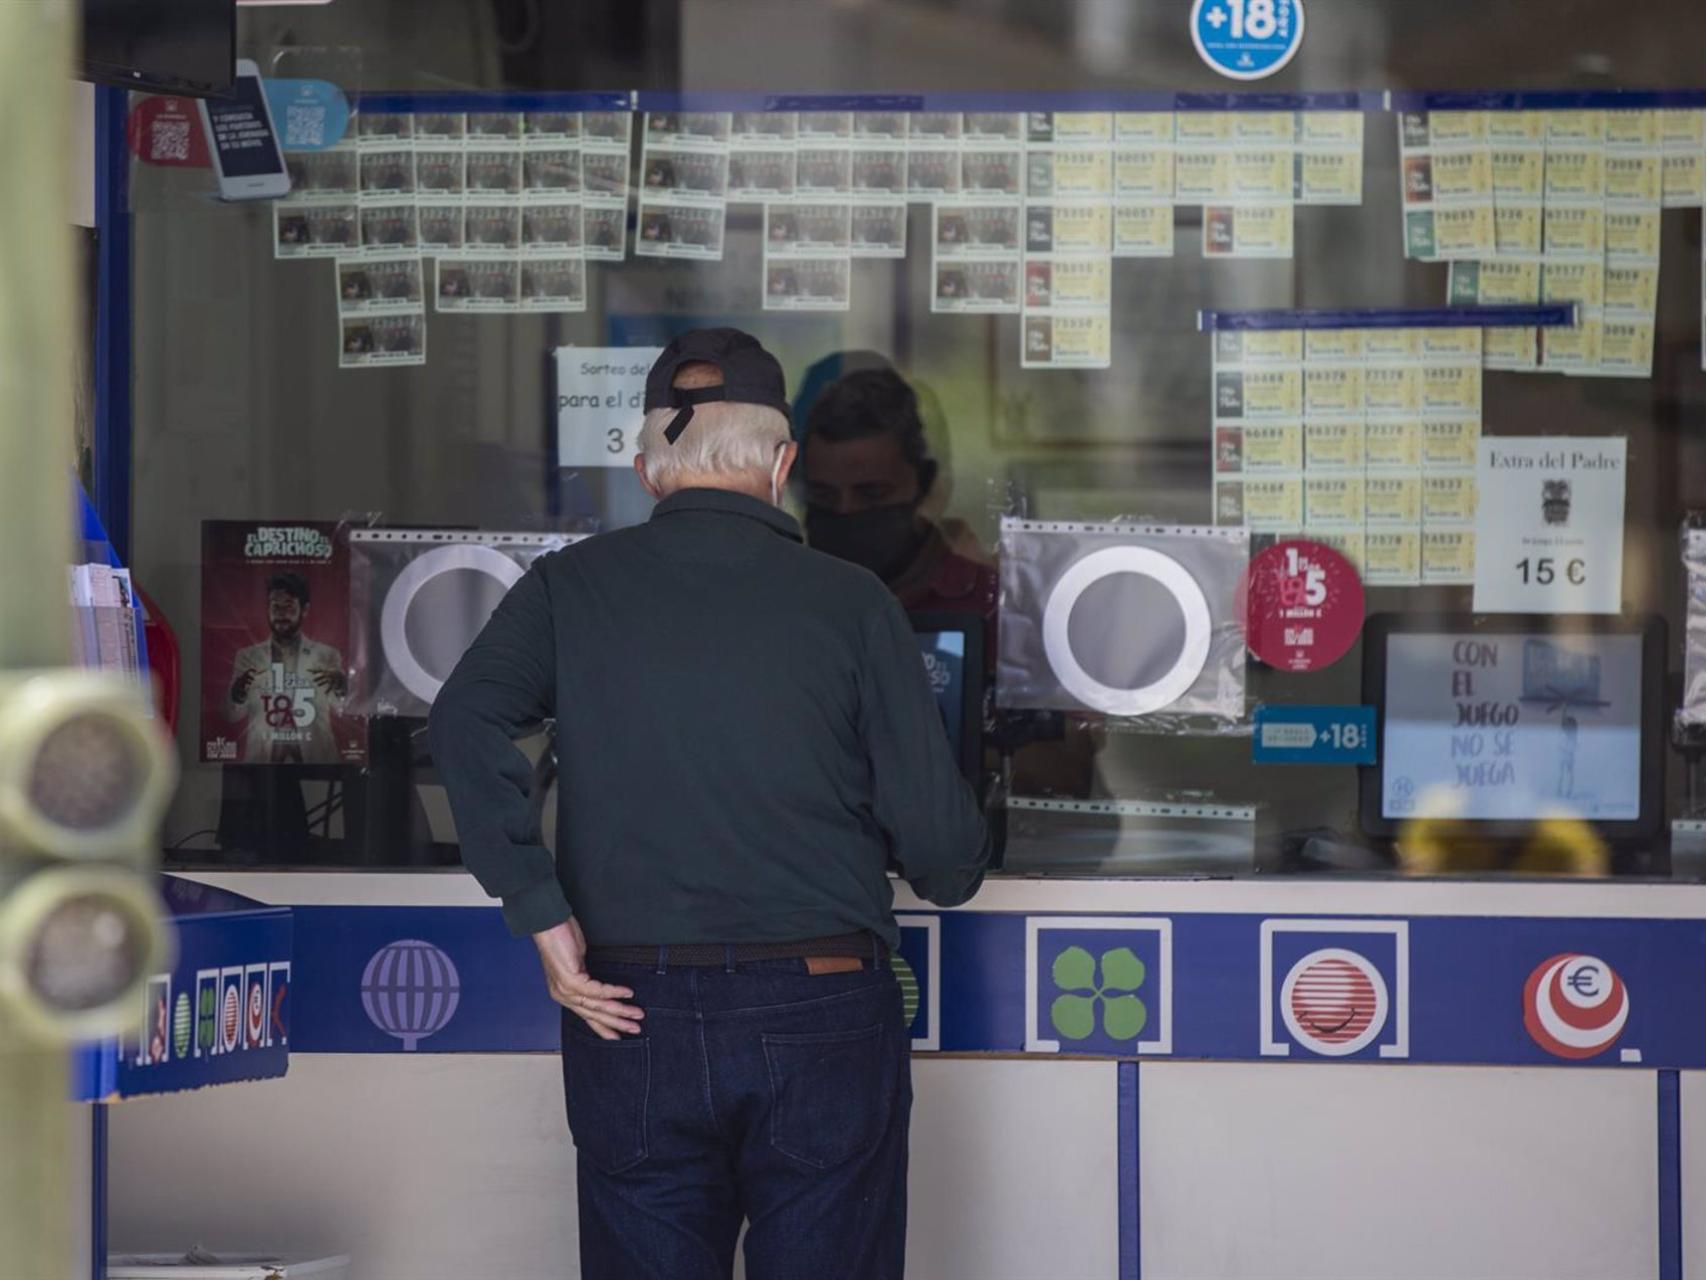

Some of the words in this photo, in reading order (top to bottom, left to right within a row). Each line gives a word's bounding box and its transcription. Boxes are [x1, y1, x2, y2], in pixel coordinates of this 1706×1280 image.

[1206, 0, 1277, 39] +18
[581, 363, 625, 375] Sorteo
[559, 394, 600, 413] para
[605, 390, 622, 408] el
[607, 427, 625, 454] 3
[1490, 452, 1534, 469] Extra
[1539, 452, 1565, 469] del
[1572, 452, 1620, 470] Padre
[257, 527, 320, 543] DESTINO
[245, 542, 332, 558] CAPRICHOSO
[1285, 547, 1299, 577] 1
[1516, 557, 1555, 585] 15
[1567, 558, 1586, 586] €
[1305, 569, 1327, 606] 5
[1453, 640, 1498, 668] CON
[272, 662, 285, 693] 1
[1452, 671, 1473, 698] EL
[293, 687, 317, 728] 5
[1452, 702, 1519, 729] JUEGO
[1320, 723, 1360, 748] +18
[1451, 731, 1484, 758] NO
[1494, 730, 1514, 756] SE
[1454, 761, 1516, 788] JUEGA
